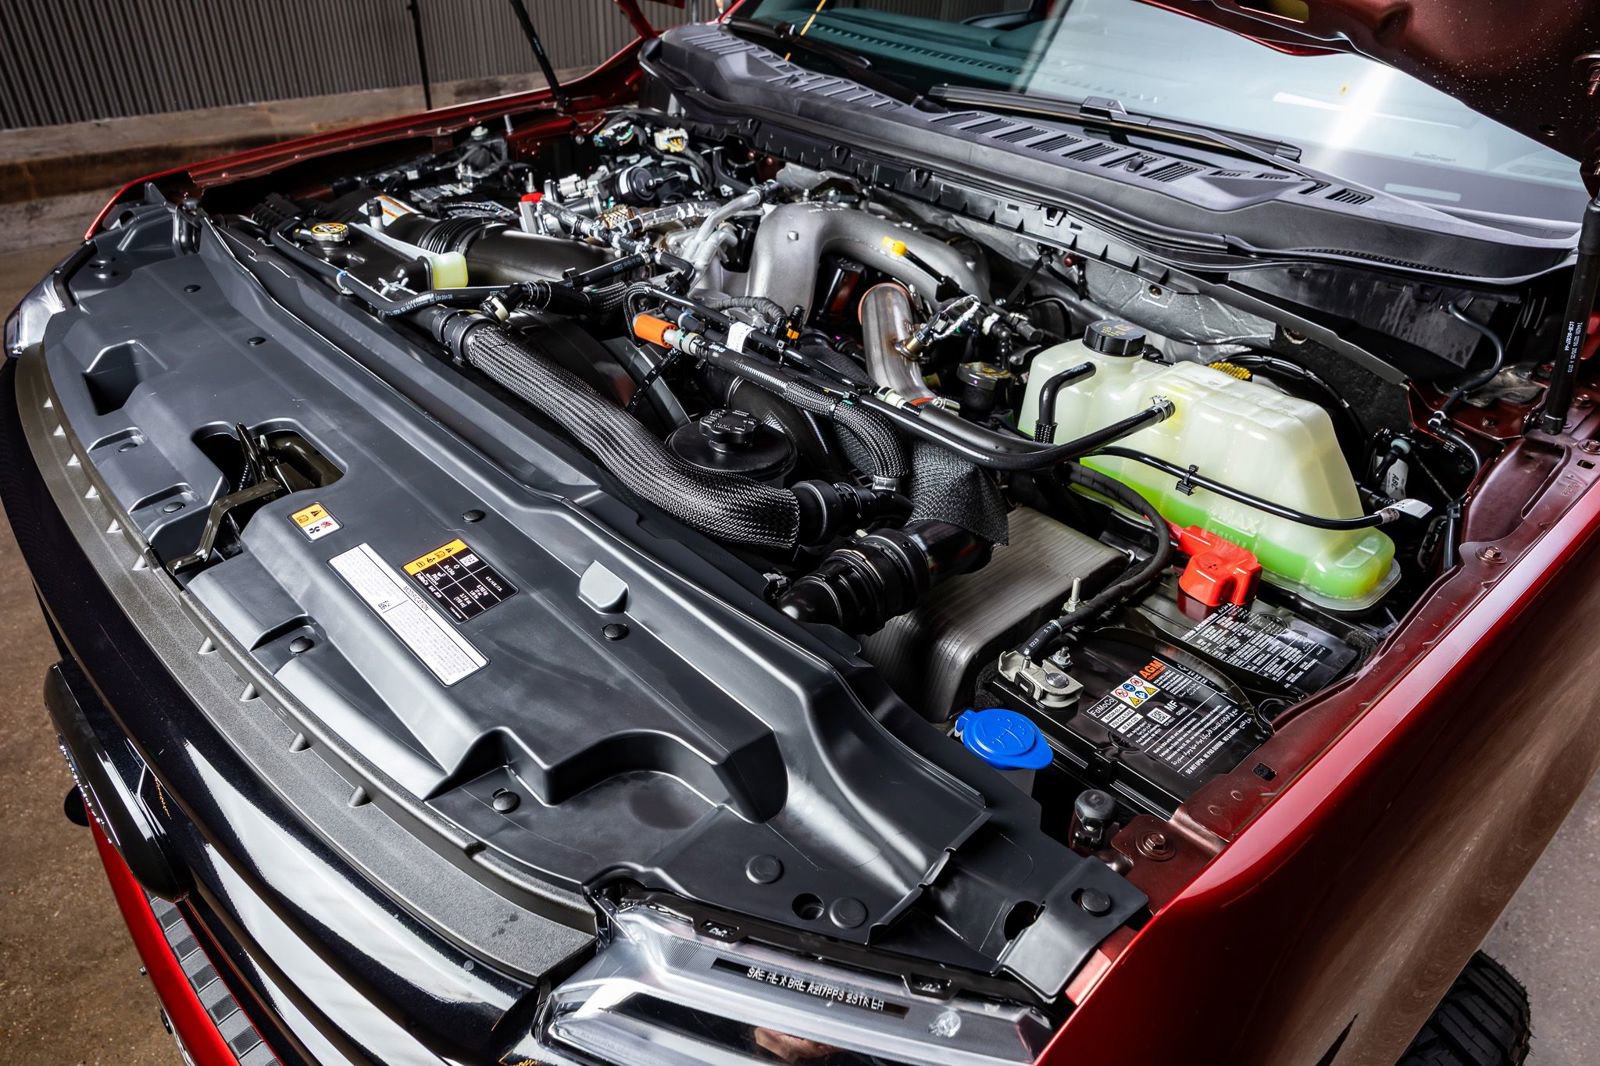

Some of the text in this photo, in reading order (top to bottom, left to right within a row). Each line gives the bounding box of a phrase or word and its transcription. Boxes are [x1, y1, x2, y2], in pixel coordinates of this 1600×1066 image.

[1139, 659, 1164, 679] AGM
[1090, 698, 1117, 717] FoMoCo
[1163, 700, 1178, 712] MF
[747, 965, 765, 981] SAE
[780, 975, 788, 987] X
